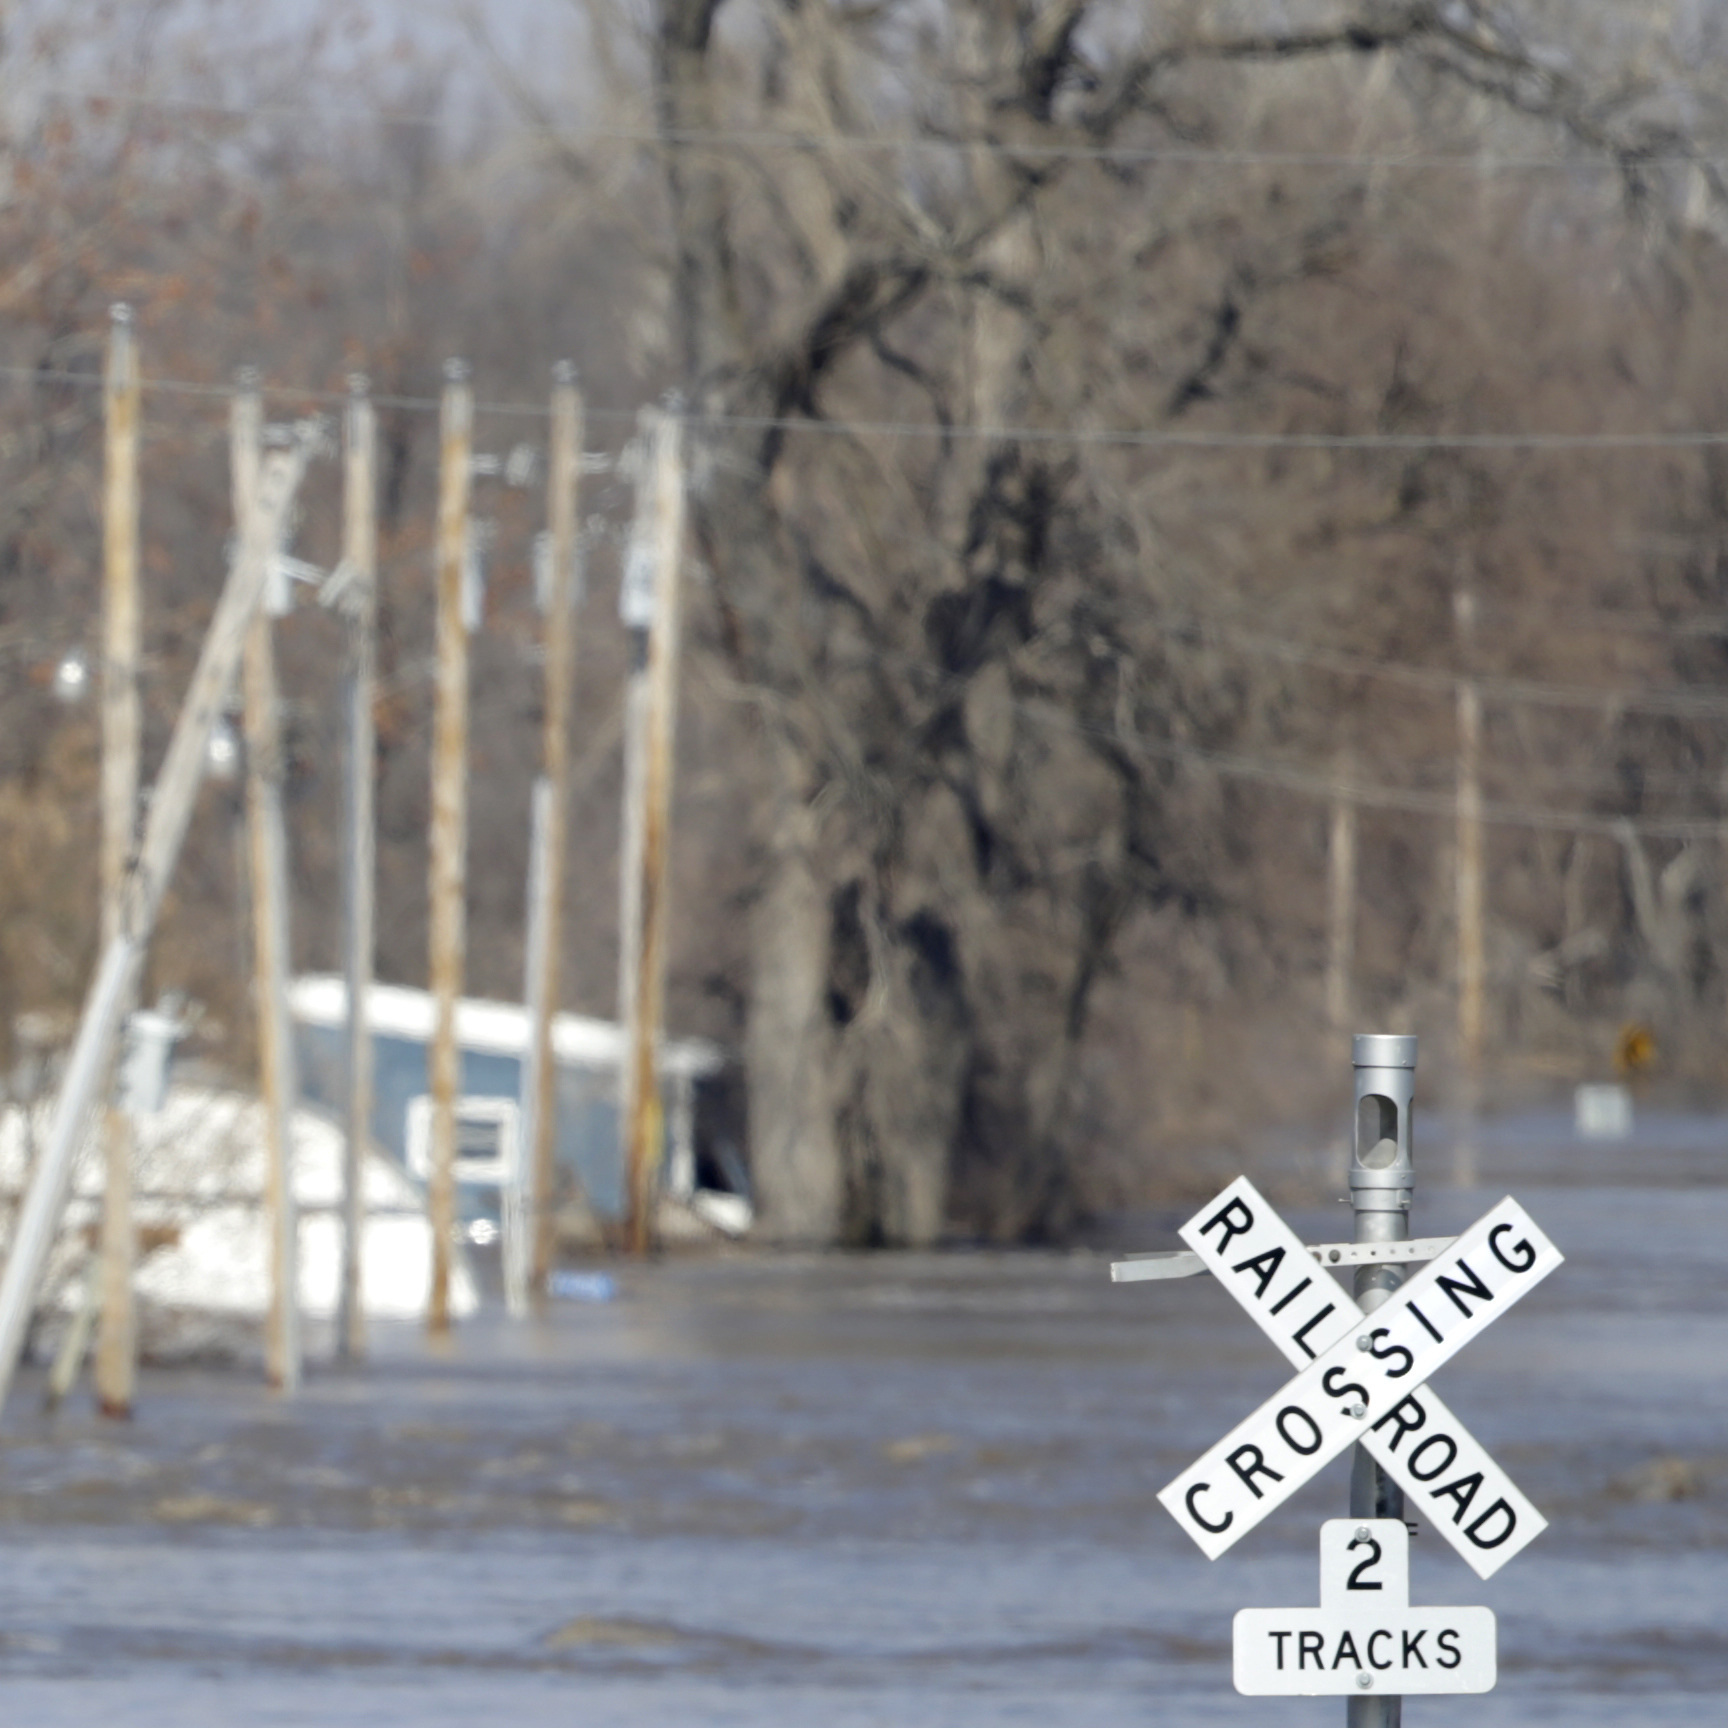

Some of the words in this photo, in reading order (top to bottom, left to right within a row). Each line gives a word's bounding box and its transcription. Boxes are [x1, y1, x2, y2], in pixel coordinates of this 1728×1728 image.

[1185, 1222, 1536, 1535] CROSSING
[1345, 1536, 1383, 1590] 2
[1268, 1629, 1462, 1670] TRACKS
